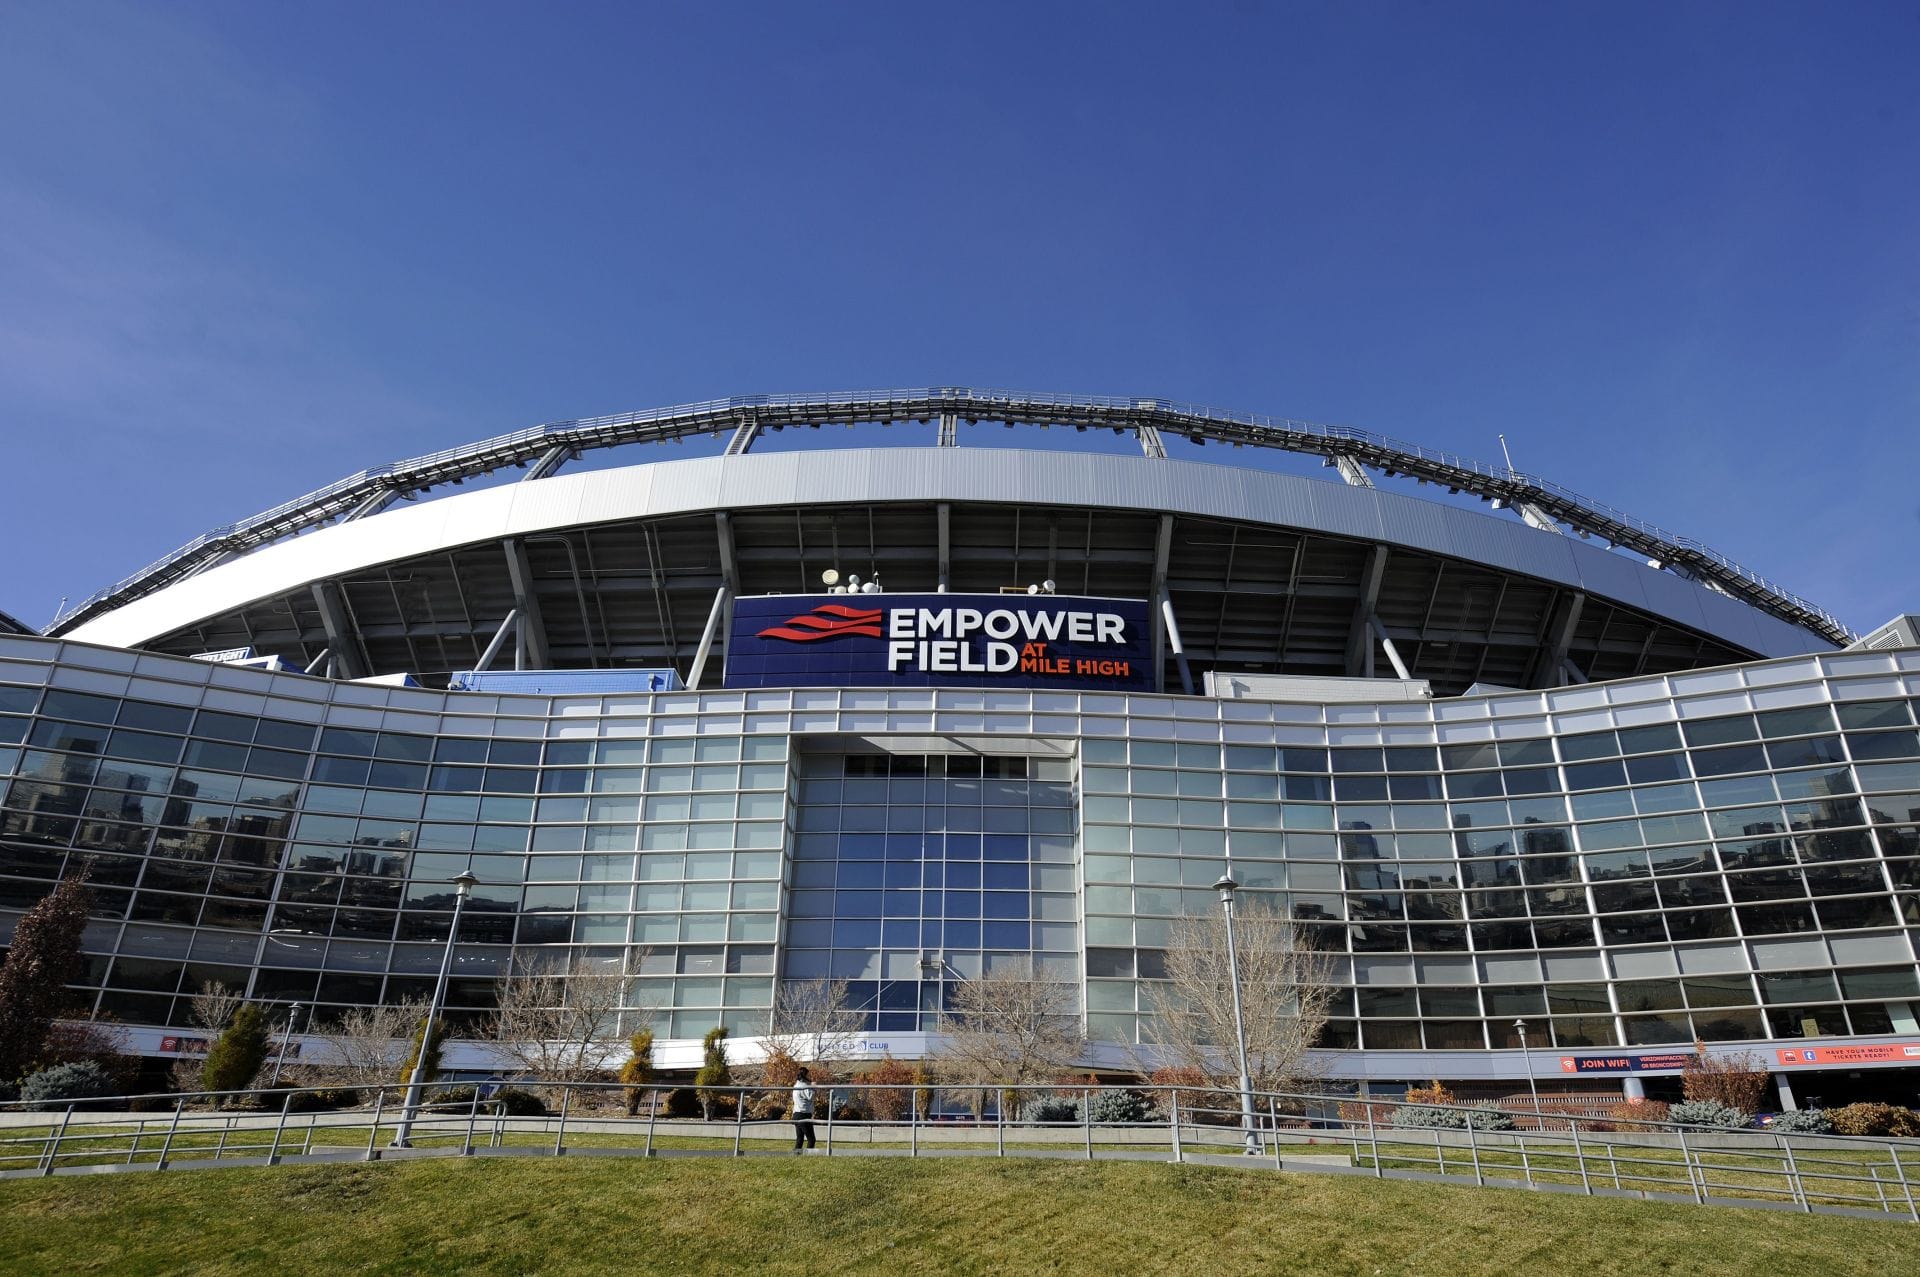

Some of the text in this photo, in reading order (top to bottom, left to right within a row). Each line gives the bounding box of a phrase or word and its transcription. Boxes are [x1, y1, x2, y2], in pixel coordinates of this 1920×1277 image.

[889, 607, 1127, 644] EMPOWER
[888, 641, 1019, 672] FIELD
[1021, 643, 1047, 657] AT
[1021, 657, 1129, 676] MILE HIGH
[1582, 1058, 1630, 1069] JOIN WIFI
